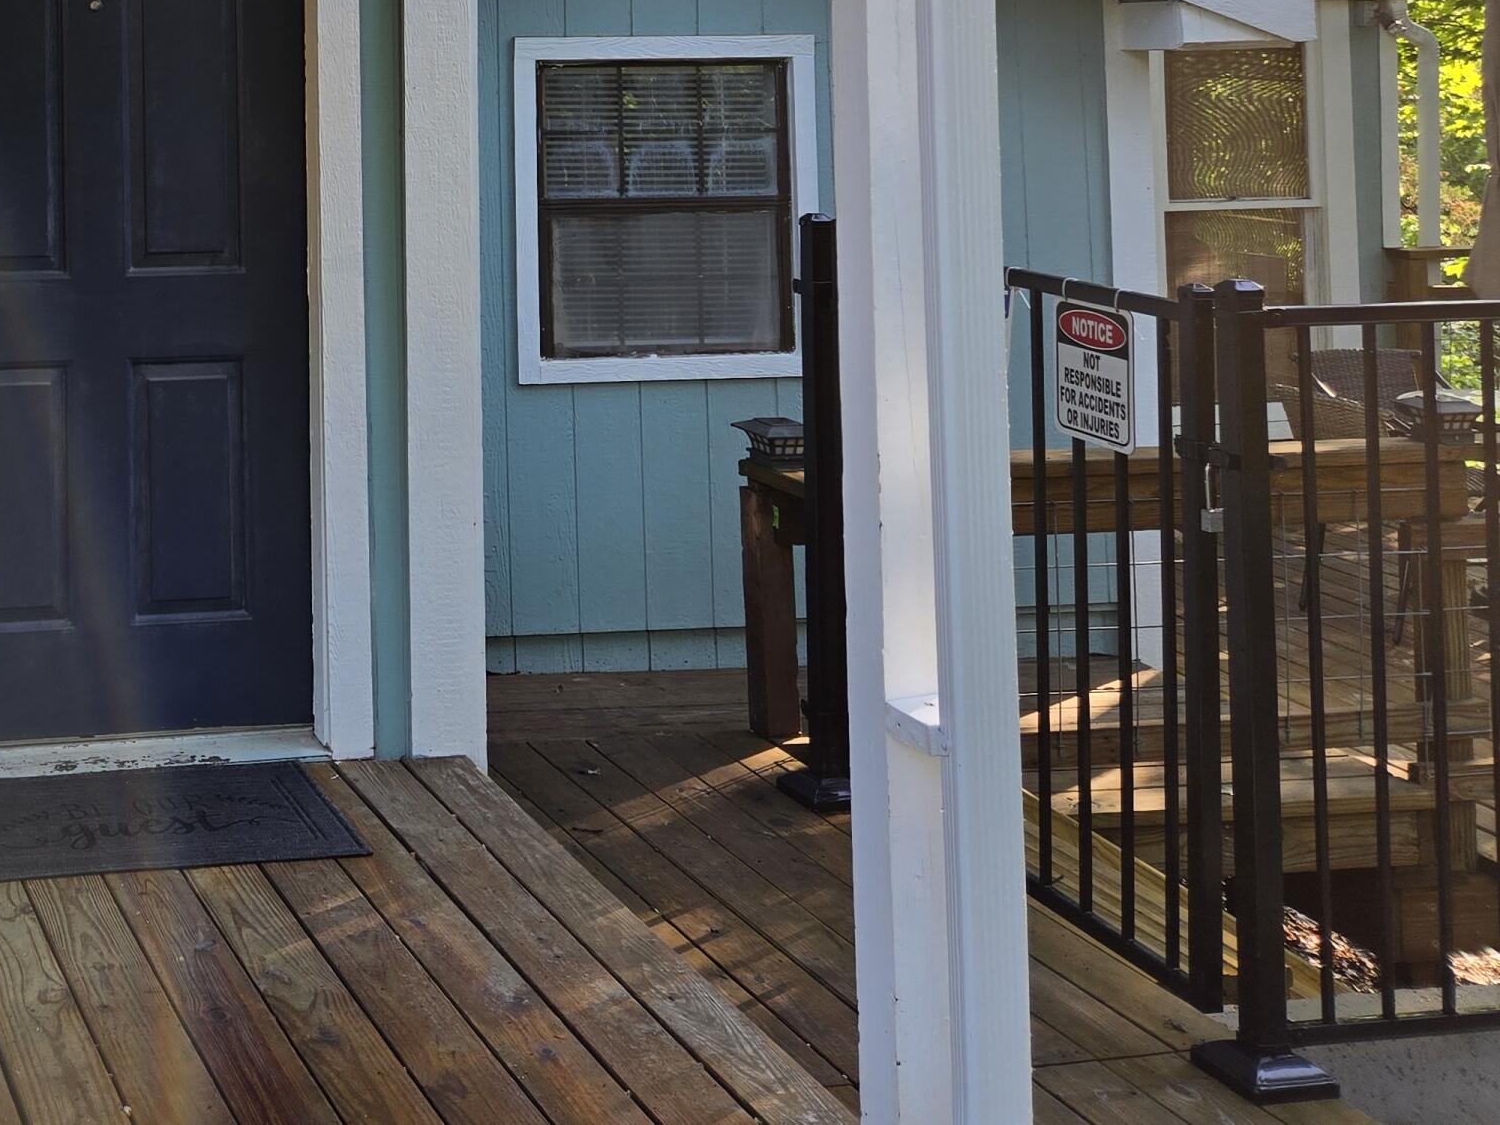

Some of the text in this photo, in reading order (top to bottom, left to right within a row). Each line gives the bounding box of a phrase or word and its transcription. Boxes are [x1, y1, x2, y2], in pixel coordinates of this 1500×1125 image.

[1071, 316, 1113, 344] NOTICE
[1083, 352, 1101, 371] NOT
[1064, 367, 1121, 398] RESPONSIBLE
[1060, 386, 1126, 420] FOR ACCIDENTS
[1066, 408, 1120, 439] OR INJURIES
[132, 793, 212, 816] OUR
[58, 810, 224, 850] guest
